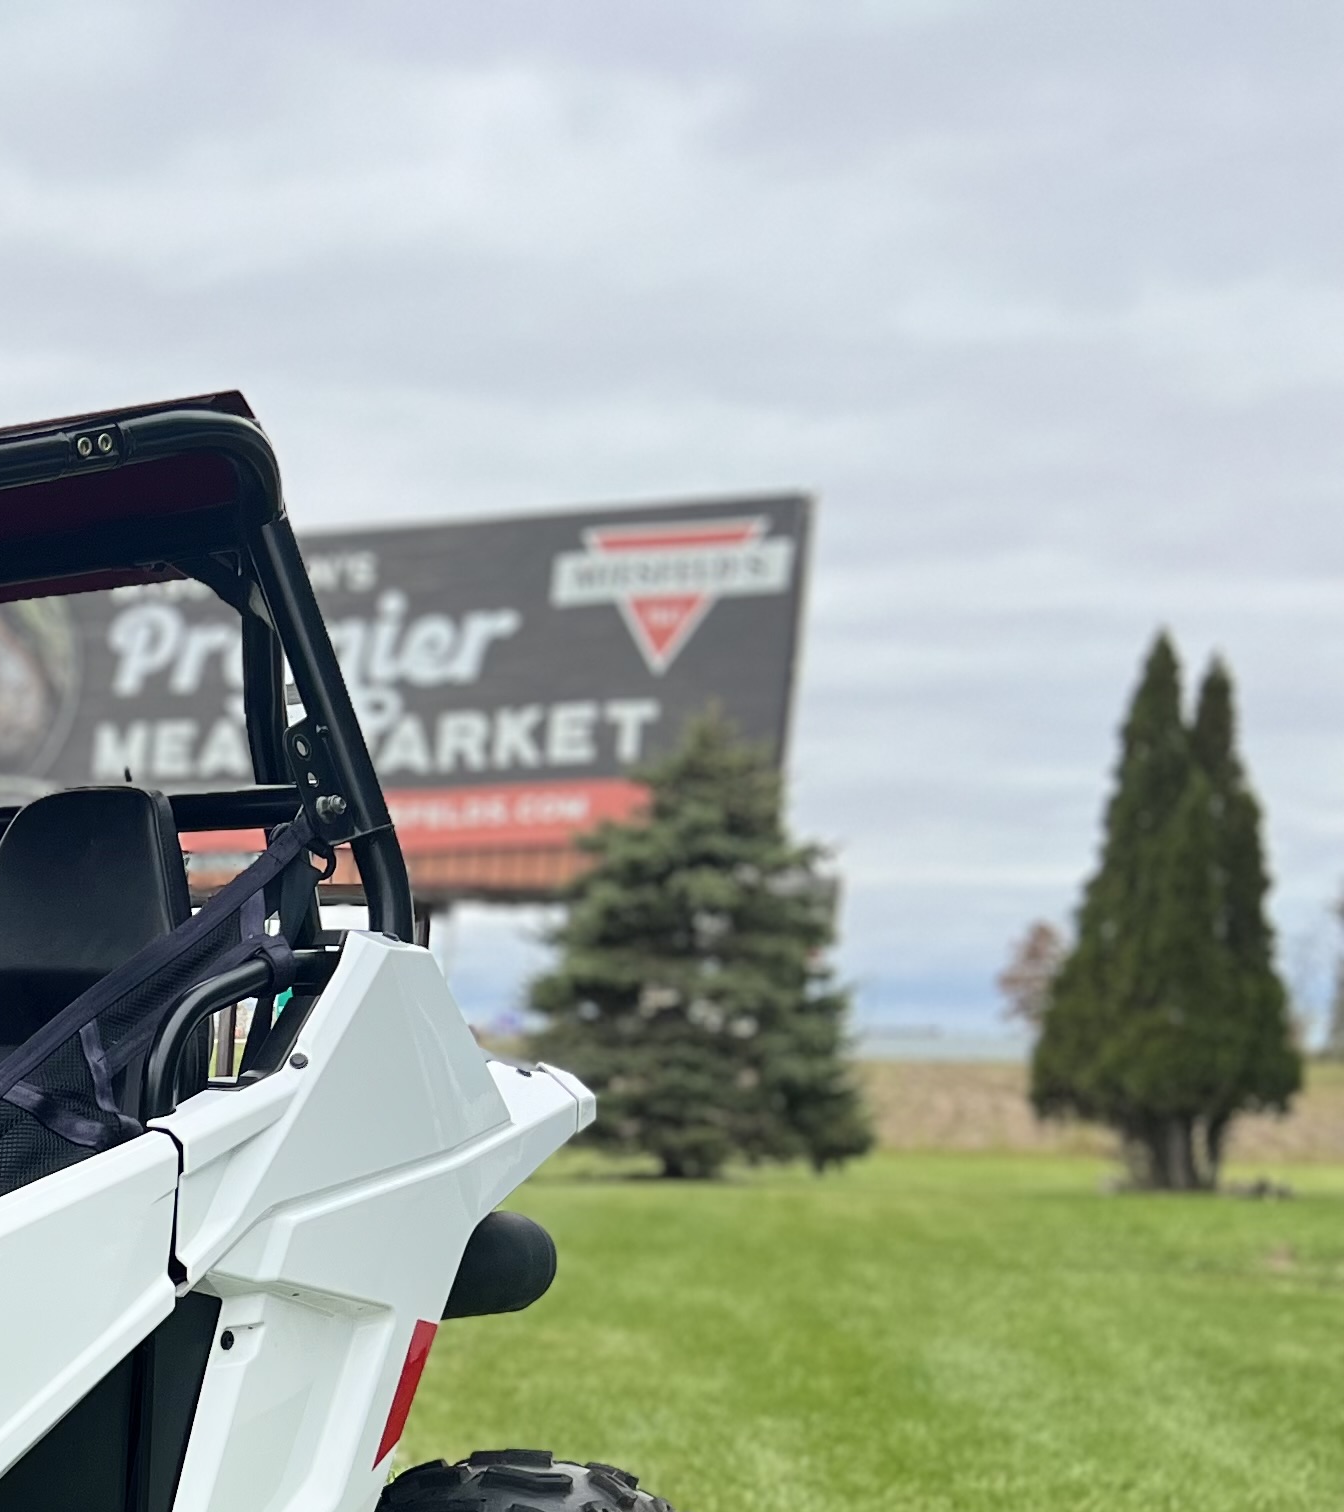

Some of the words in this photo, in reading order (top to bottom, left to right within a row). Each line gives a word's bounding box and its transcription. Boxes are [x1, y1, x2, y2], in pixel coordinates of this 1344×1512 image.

[108, 590, 523, 696] Prier
[91, 716, 254, 780] MEA
[378, 697, 663, 776] ARKET
